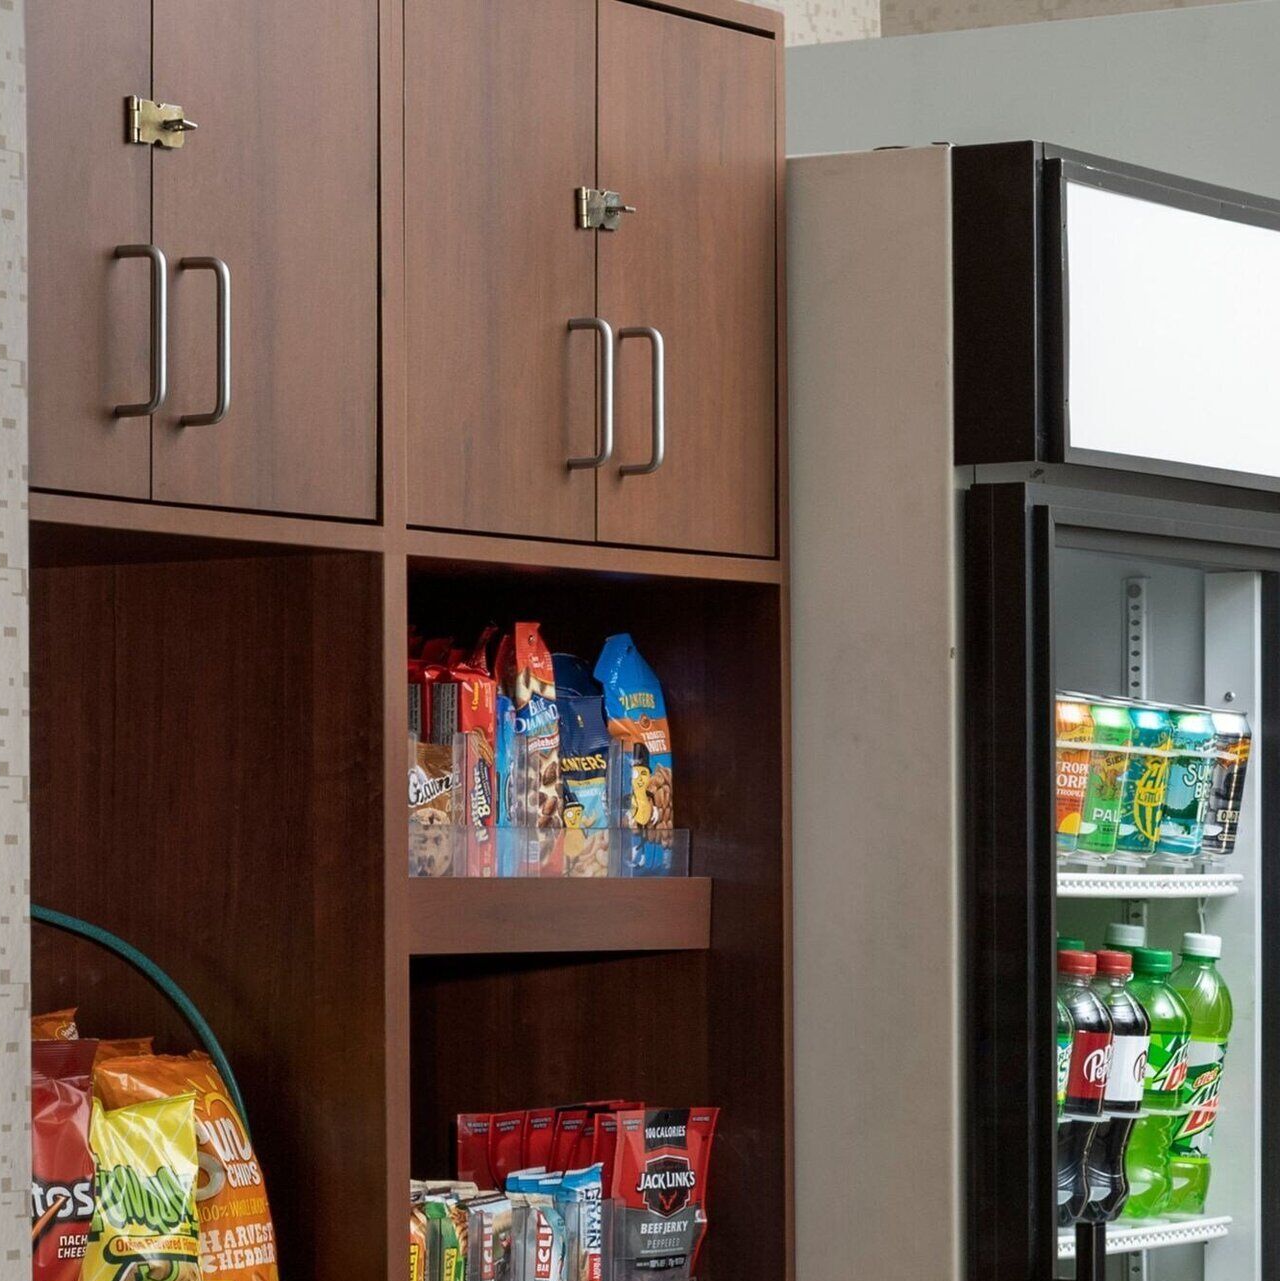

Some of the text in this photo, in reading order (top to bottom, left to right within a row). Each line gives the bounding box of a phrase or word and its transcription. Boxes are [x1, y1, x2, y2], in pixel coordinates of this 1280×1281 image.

[656, 1125, 687, 1139] CALORIES
[227, 1160, 262, 1188] CHIPS
[637, 1170, 696, 1192] JACK LINK'S
[32, 1182, 95, 1219] tos
[200, 1222, 273, 1254] HARVEST
[640, 1220, 688, 1235] BEEF JERKY
